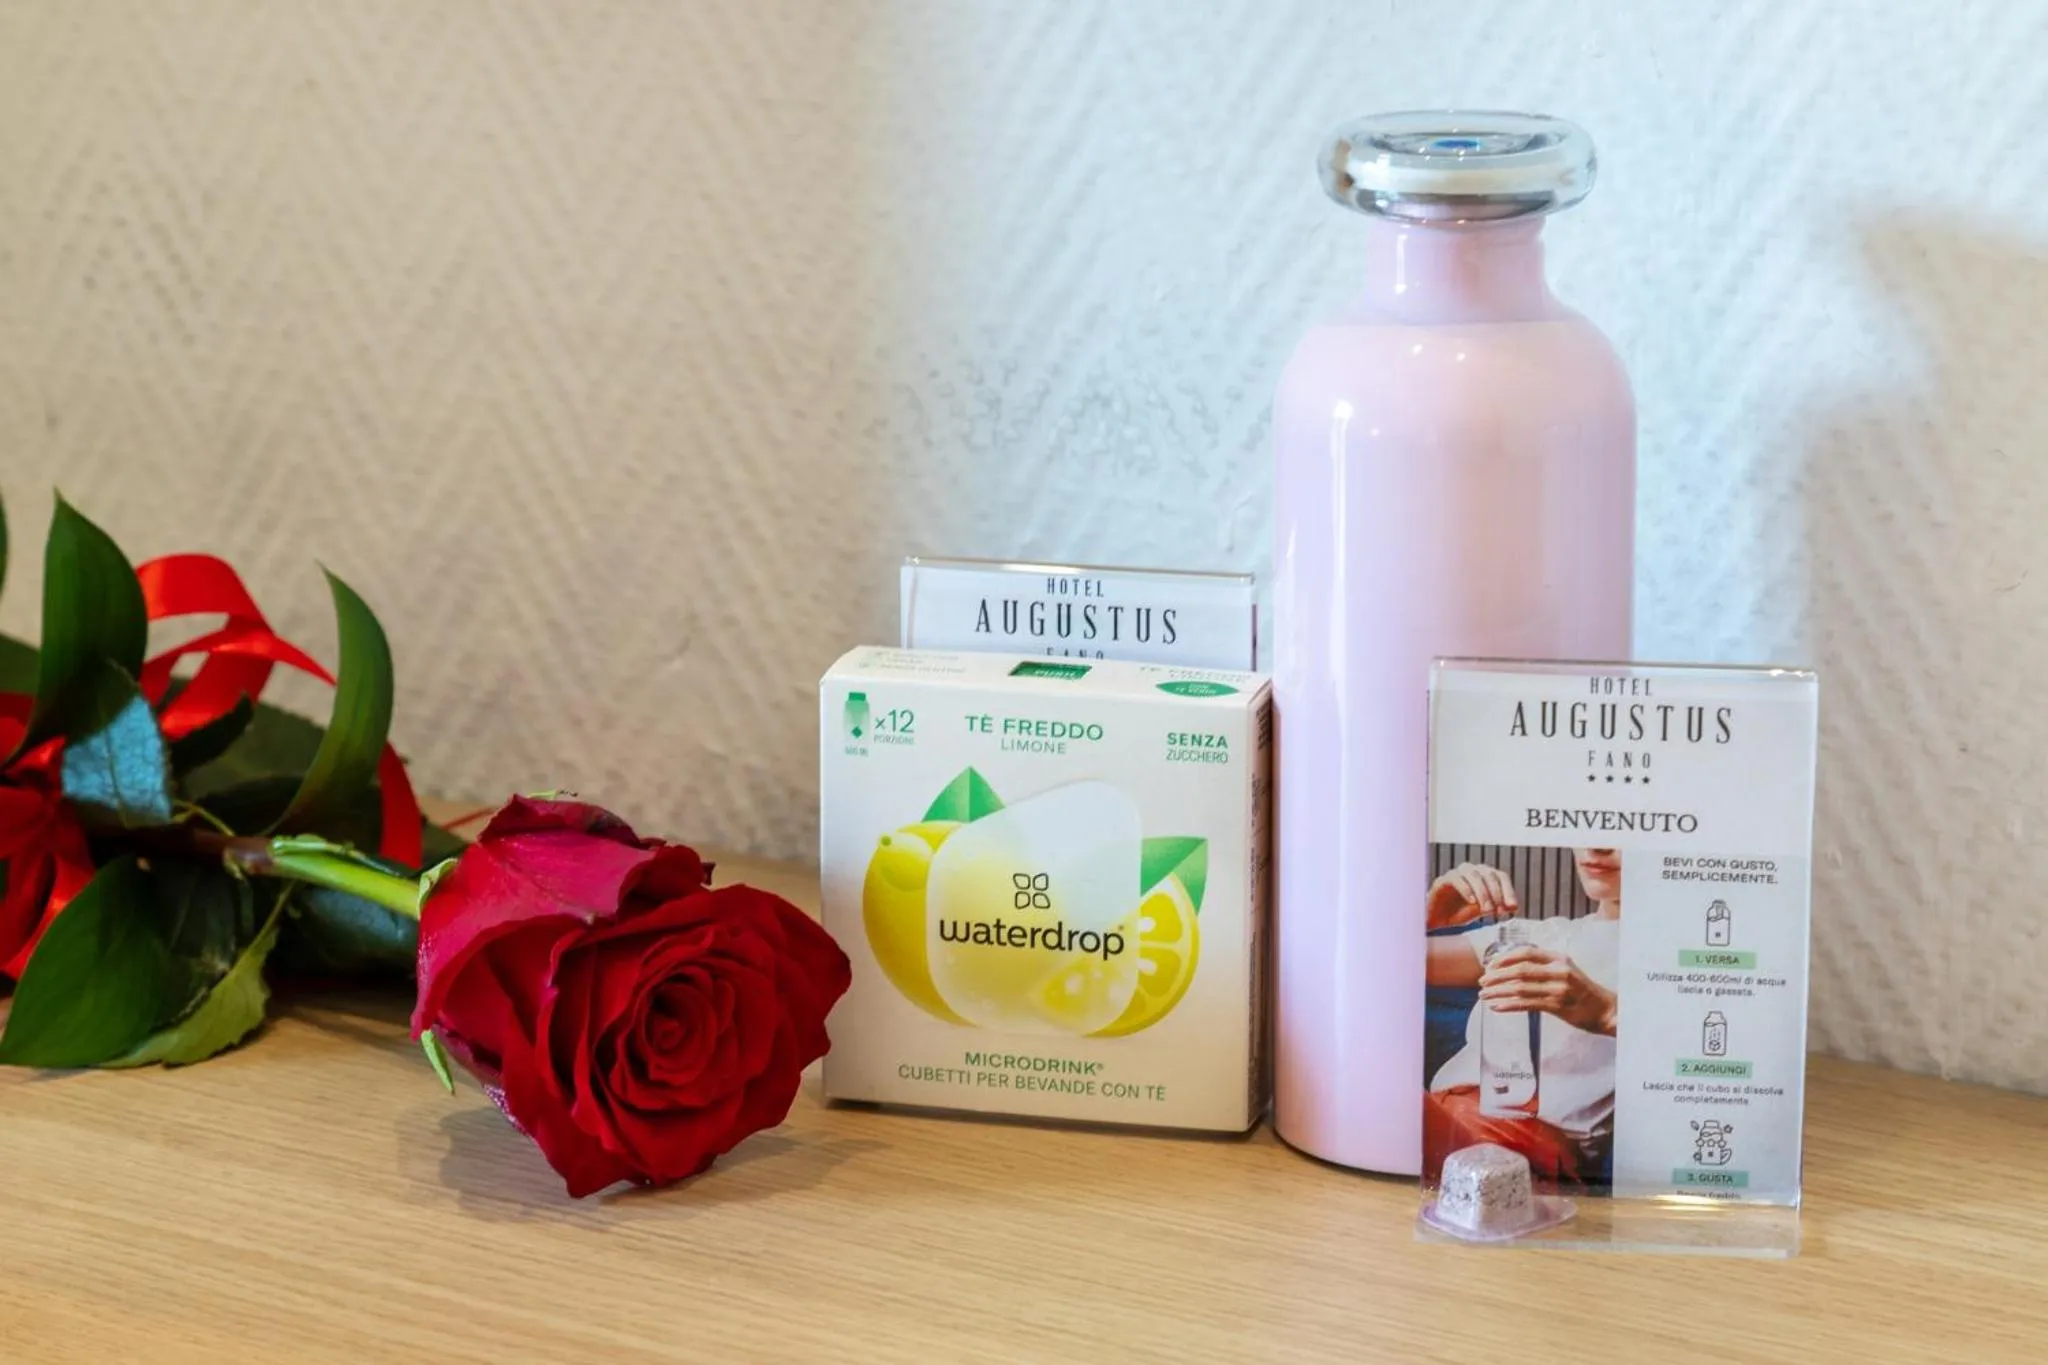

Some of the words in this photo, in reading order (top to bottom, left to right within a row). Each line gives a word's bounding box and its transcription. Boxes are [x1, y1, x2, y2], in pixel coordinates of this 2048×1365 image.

[1047, 577, 1104, 598] HOTEL
[975, 598, 1178, 645] AUGUSTUS
[1589, 677, 1652, 696] HOTEL
[874, 709, 914, 734] x12
[964, 713, 993, 734] TÈ
[1003, 718, 1104, 741] FREDDO
[1510, 700, 1733, 744] AUGUSTUS
[1000, 740, 1067, 755] LIMONE
[1167, 732, 1228, 749] SENZA
[1166, 749, 1228, 764] ZUCCHERO
[1588, 750, 1651, 769] FANO
[1525, 808, 1698, 834] BENVENUTO
[1663, 856, 1693, 868] BEVI
[1696, 857, 1726, 869] CON
[1662, 870, 1778, 884] SEMPLICEMENTE.
[939, 919, 1124, 960] waterdrop
[1705, 955, 1740, 965] VERSA
[1647, 972, 1683, 982] Utilizza
[1744, 976, 1754, 985] di
[1681, 1063, 1690, 1073] 2.
[1693, 1064, 1746, 1075] AGGIUNGI
[898, 1064, 971, 1085] CUBETTI
[977, 1072, 1009, 1088] PER
[1015, 1074, 1097, 1096] BEVANDE
[1101, 1082, 1140, 1099] CON
[1642, 1081, 1674, 1091] Lascia
[1677, 1083, 1694, 1092] che
[1706, 1084, 1729, 1093] cubo
[1732, 1085, 1741, 1094] si
[1743, 1086, 1784, 1096] dissolva
[1673, 1095, 1749, 1105] completamente
[1698, 1172, 1734, 1185] GUSTA
